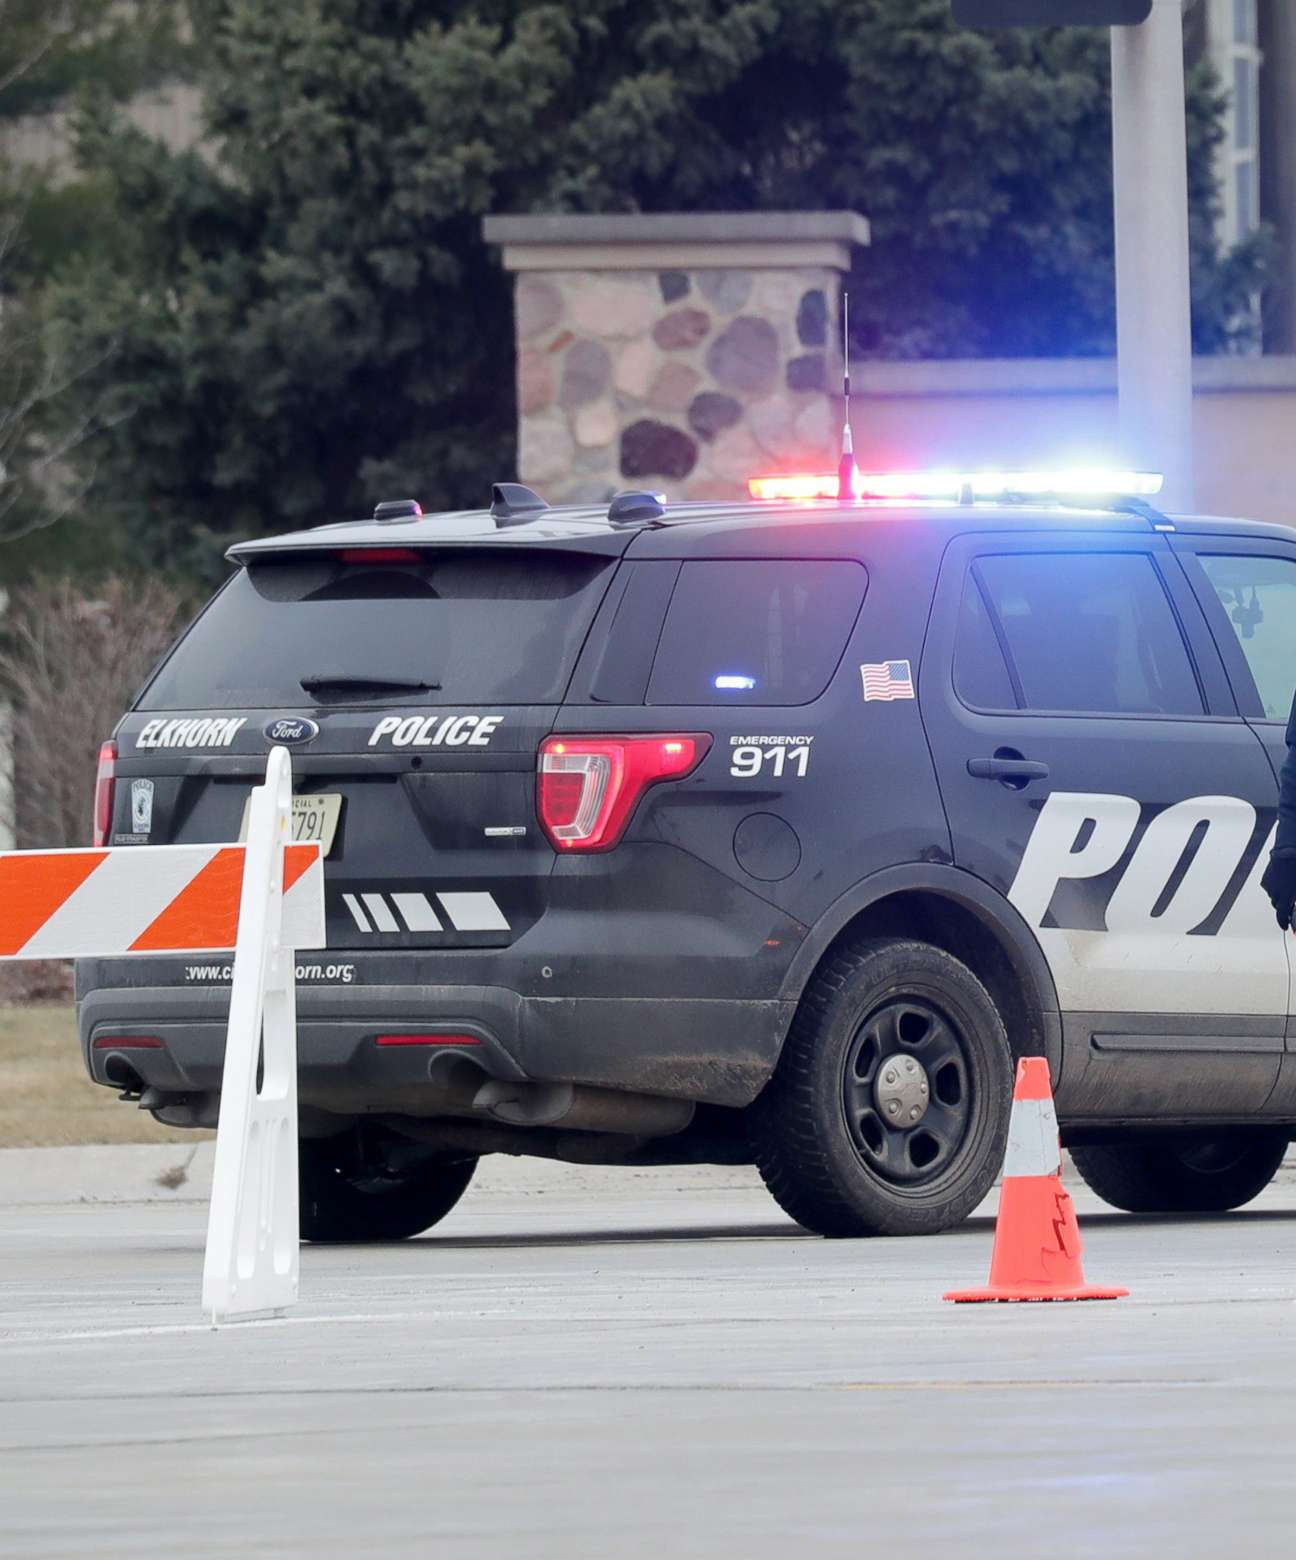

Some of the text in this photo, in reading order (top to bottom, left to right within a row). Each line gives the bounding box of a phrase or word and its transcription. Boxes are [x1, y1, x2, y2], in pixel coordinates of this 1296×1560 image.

[135, 717, 248, 748] ELKHORN
[271, 720, 303, 739] Ford
[367, 715, 505, 746] POLICE
[730, 735, 814, 745] EMERGENCY
[730, 746, 810, 777] 911
